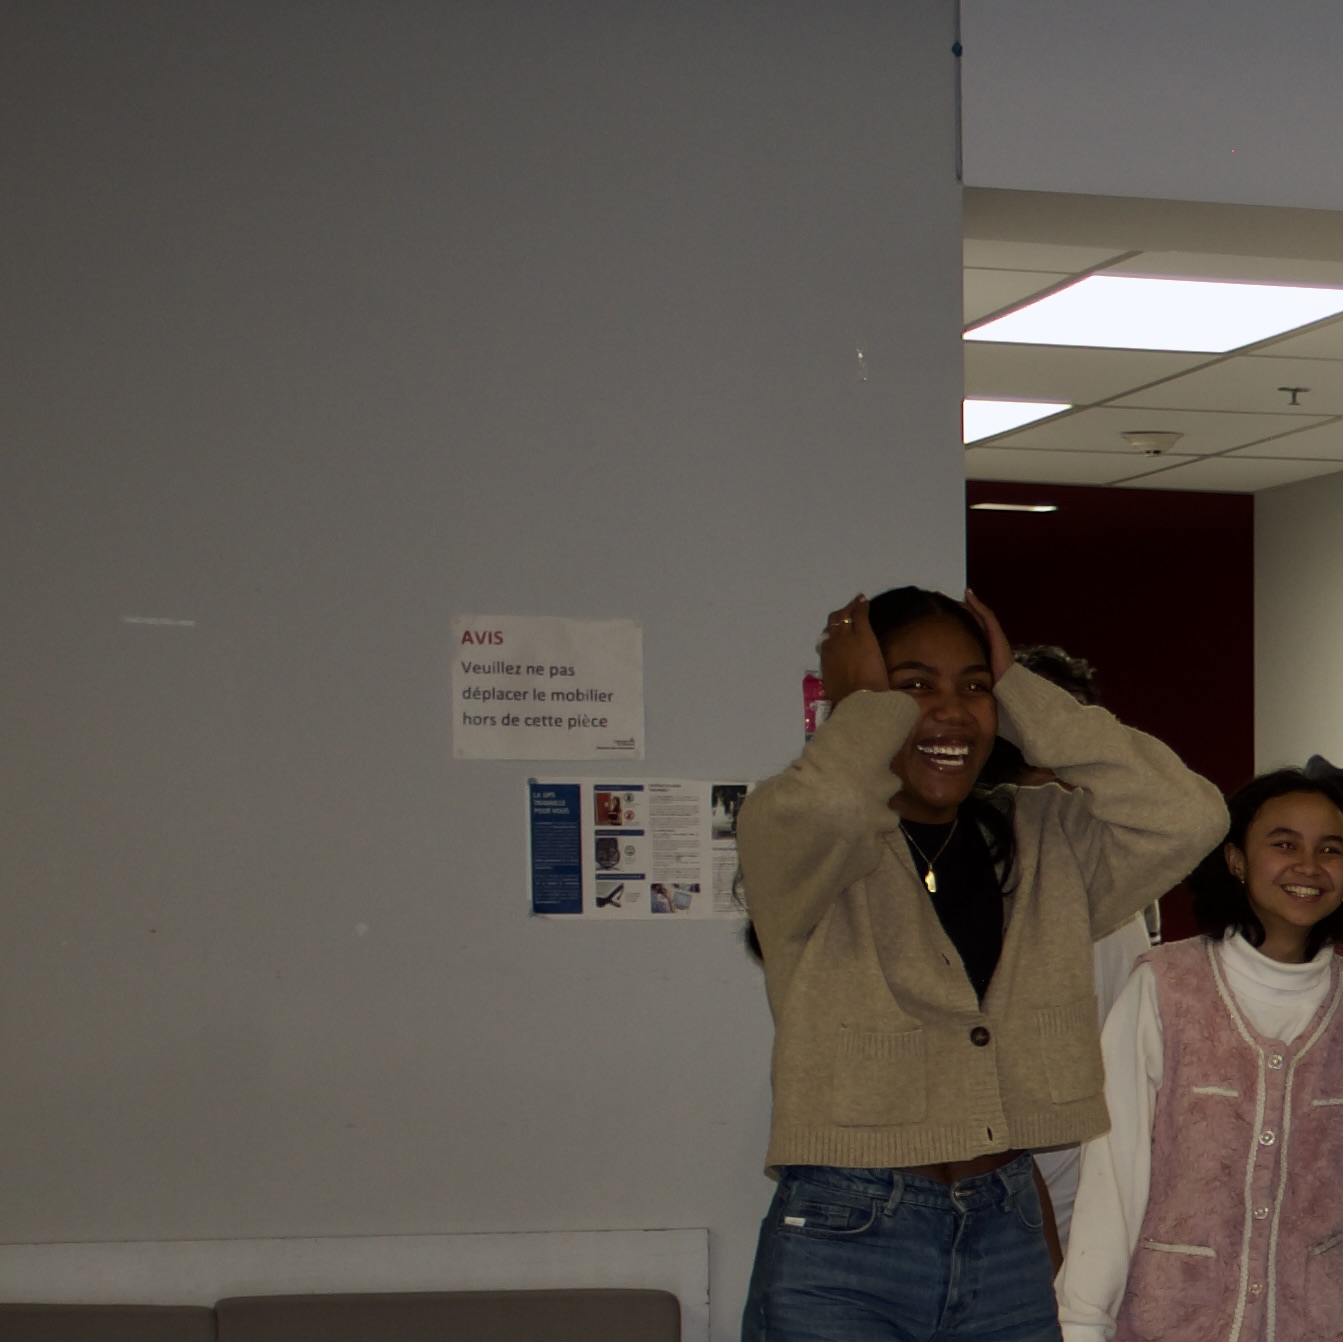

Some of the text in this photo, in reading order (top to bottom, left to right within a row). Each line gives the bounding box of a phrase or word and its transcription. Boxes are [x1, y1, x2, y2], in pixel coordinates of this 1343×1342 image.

[461, 630, 504, 646] AVIS
[461, 661, 576, 678] Veuillez ne pas
[462, 686, 614, 702] déplacer le mobilier
[462, 711, 609, 730] hors de cette pièce
